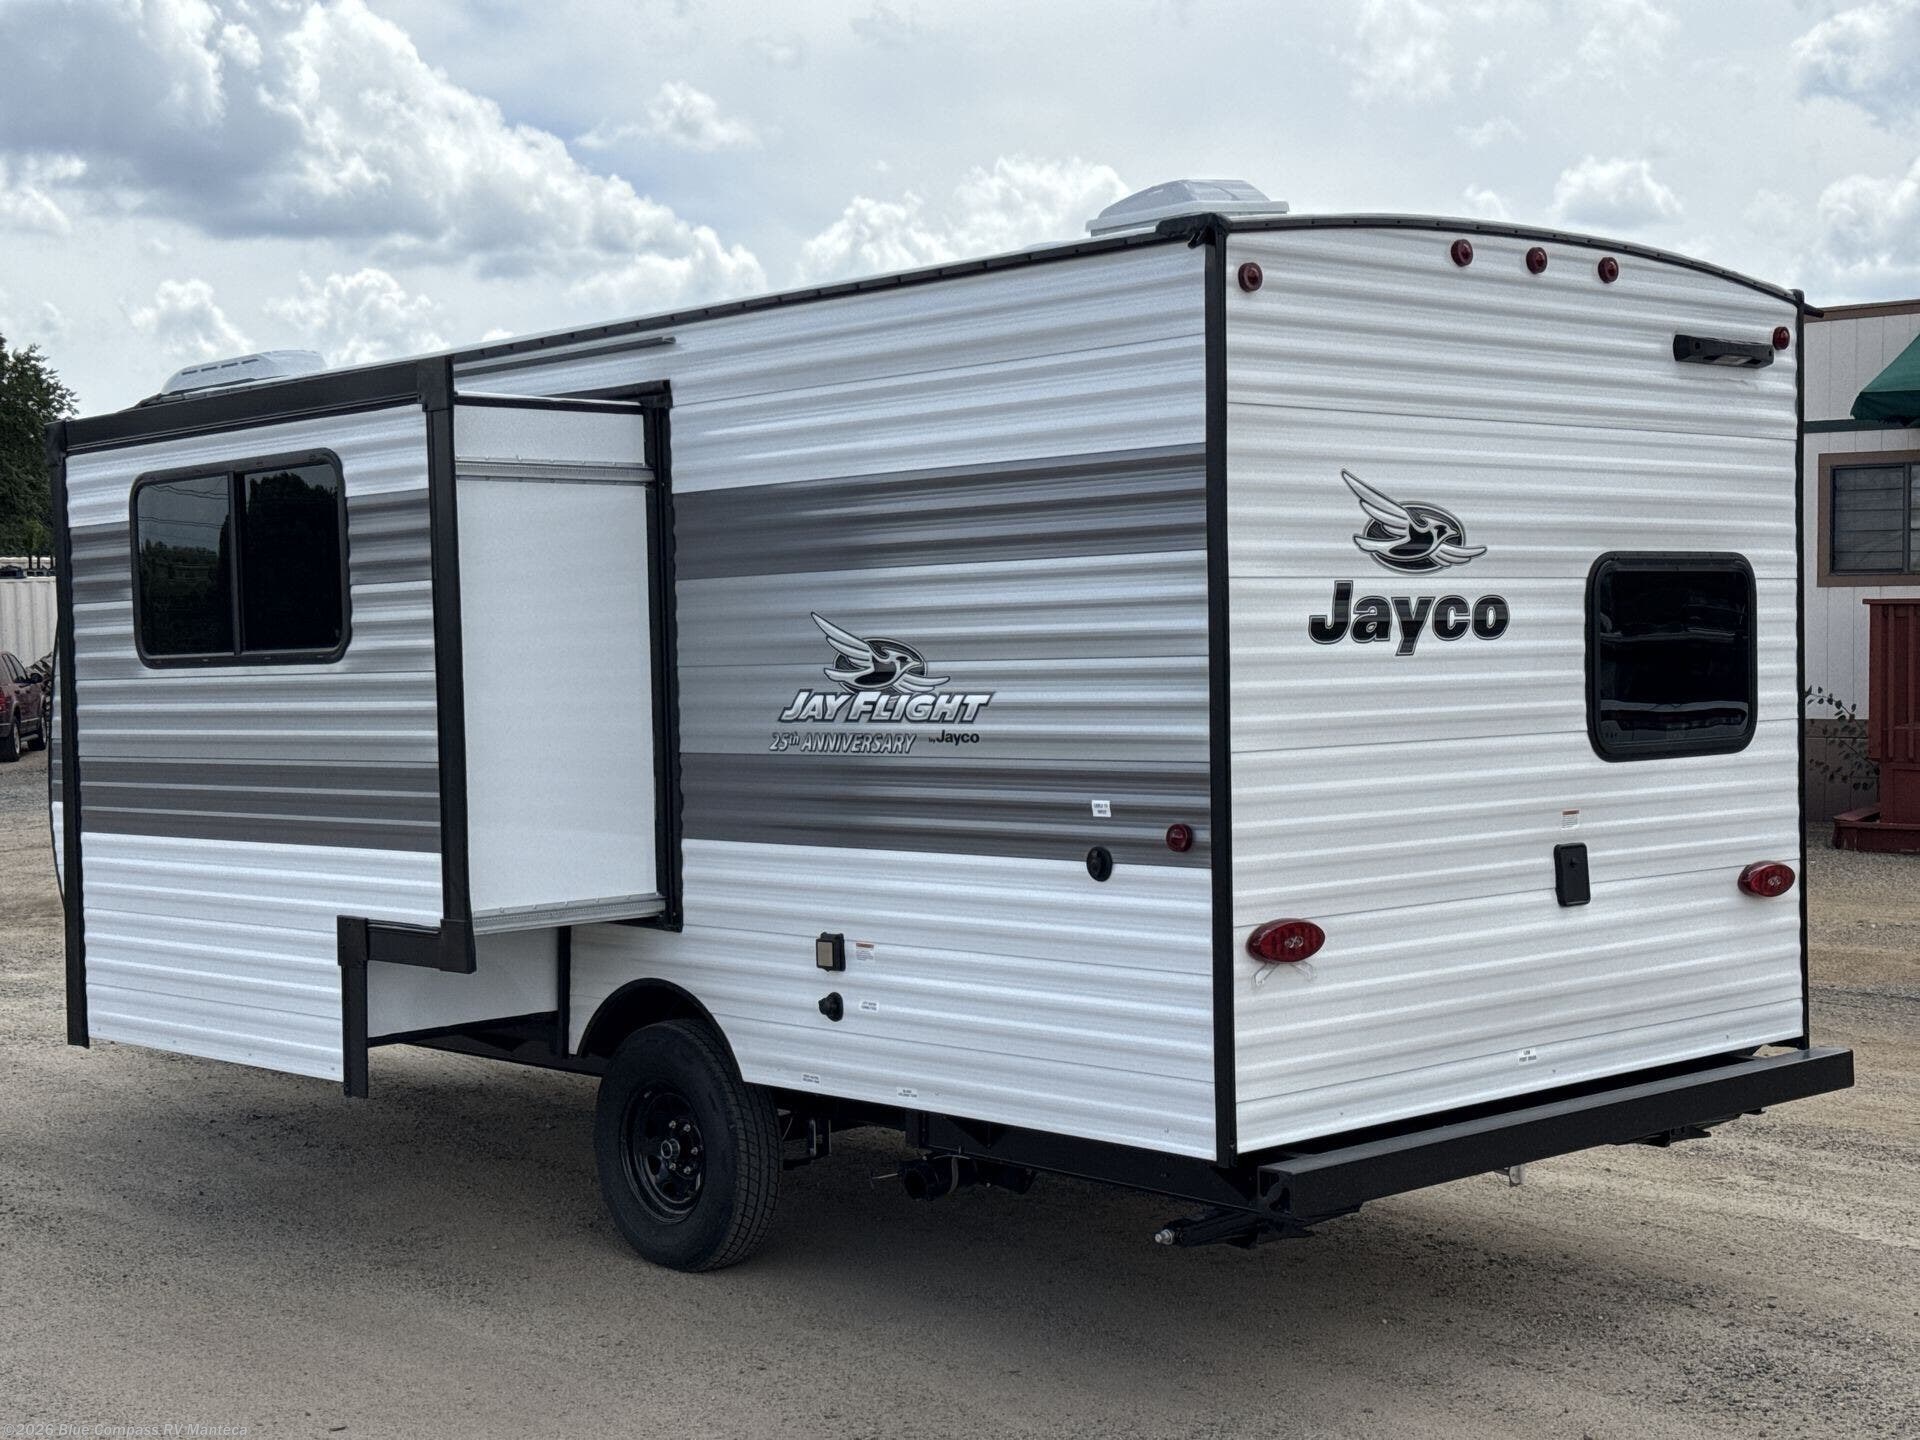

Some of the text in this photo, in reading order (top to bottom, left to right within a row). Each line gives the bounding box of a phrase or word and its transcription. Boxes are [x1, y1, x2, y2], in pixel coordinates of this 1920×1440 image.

[1308, 579, 1511, 656] Jayco
[779, 689, 996, 723] JAY FLIGHT
[769, 731, 916, 753] 25th ANNIVERSARY
[936, 729, 980, 746] Jayco
